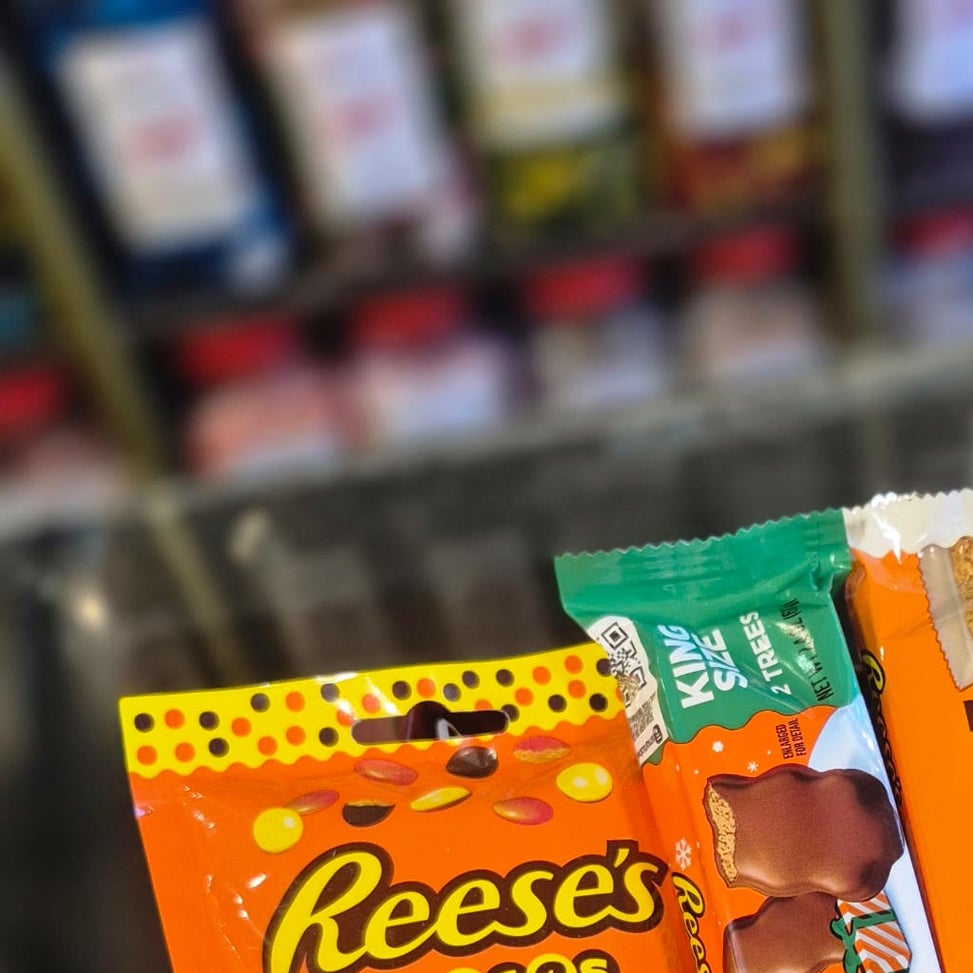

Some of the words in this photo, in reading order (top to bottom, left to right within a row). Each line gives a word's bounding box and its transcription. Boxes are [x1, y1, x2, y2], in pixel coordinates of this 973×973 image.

[690, 628, 748, 692] SIZE
[739, 611, 779, 682] TREES
[657, 624, 714, 709] KING
[773, 684, 793, 696] 2
[811, 677, 834, 702] NET
[775, 724, 794, 759] ENLARGED
[787, 717, 804, 737] DETAIL
[795, 736, 807, 756] FOR
